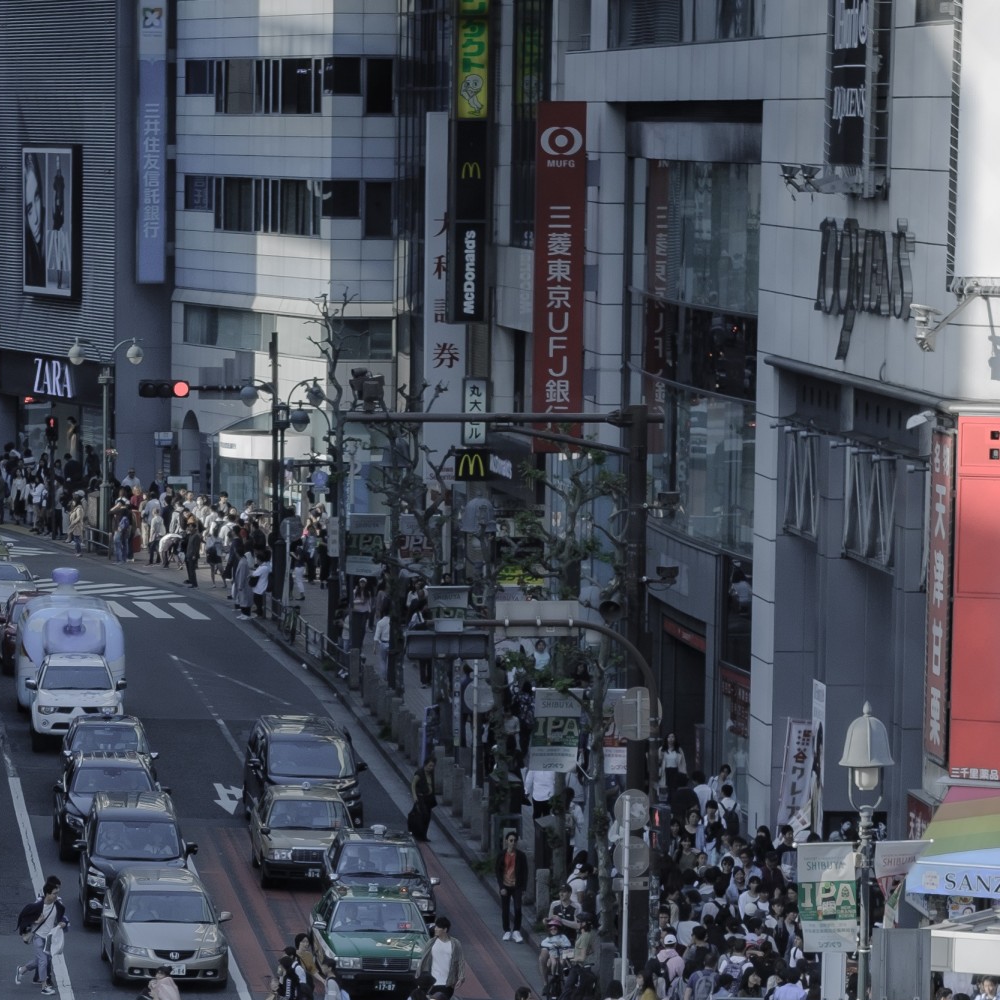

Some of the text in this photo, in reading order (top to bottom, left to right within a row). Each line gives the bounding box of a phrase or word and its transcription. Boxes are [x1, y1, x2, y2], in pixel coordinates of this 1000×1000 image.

[143, 103, 161, 239] 三井住友信託銀行
[547, 159, 576, 168] MUFG
[463, 229, 476, 315] McDonald's
[33, 357, 74, 398] ZARA
[541, 700, 574, 710] SHIBUYA
[535, 717, 578, 737] IPA
[950, 767, 1000, 781] 三千里薬品
[806, 859, 846, 871] SHIBUYA
[801, 882, 857, 909] IPA
